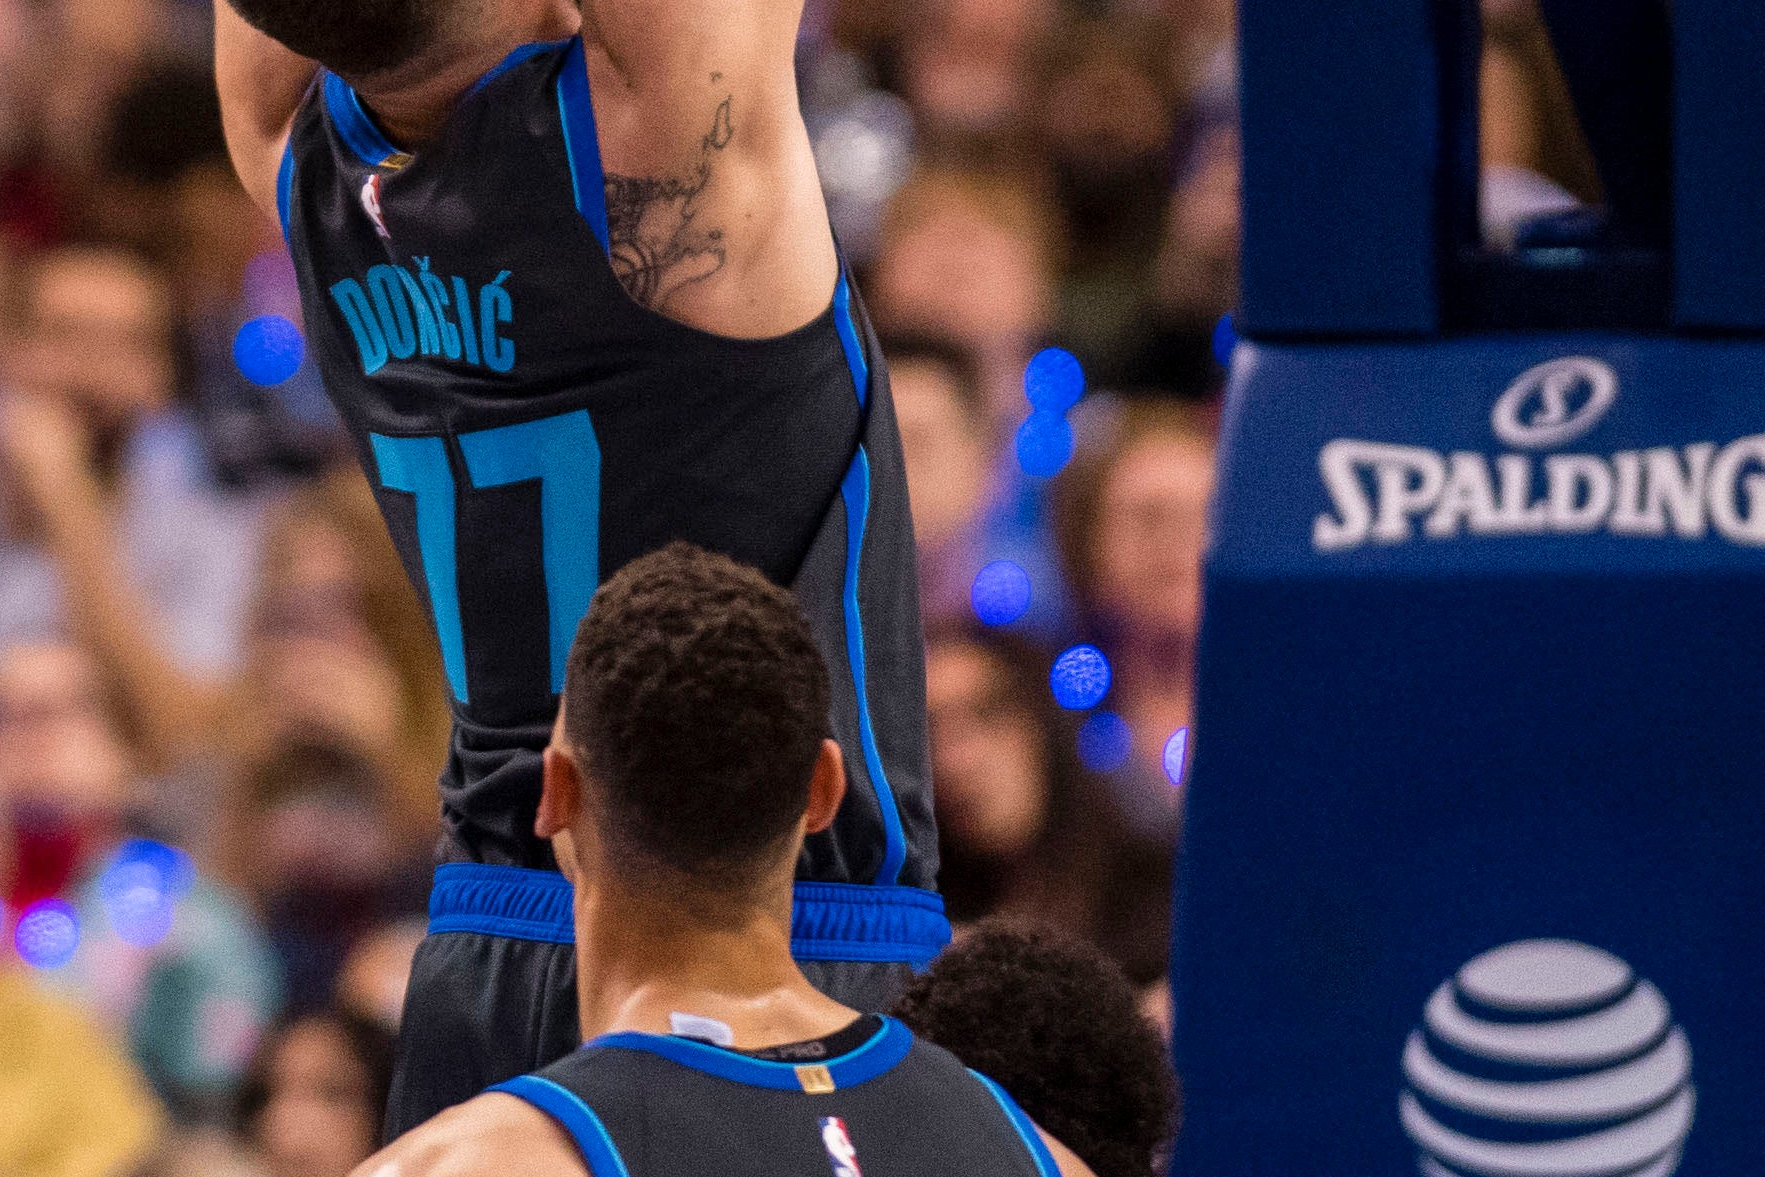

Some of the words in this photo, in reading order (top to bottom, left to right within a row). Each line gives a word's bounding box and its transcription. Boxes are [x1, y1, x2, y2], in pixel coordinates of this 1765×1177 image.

[330, 255, 516, 375] DONČIĆ
[1314, 437, 1765, 550] SPALDING
[369, 408, 602, 704] 77
